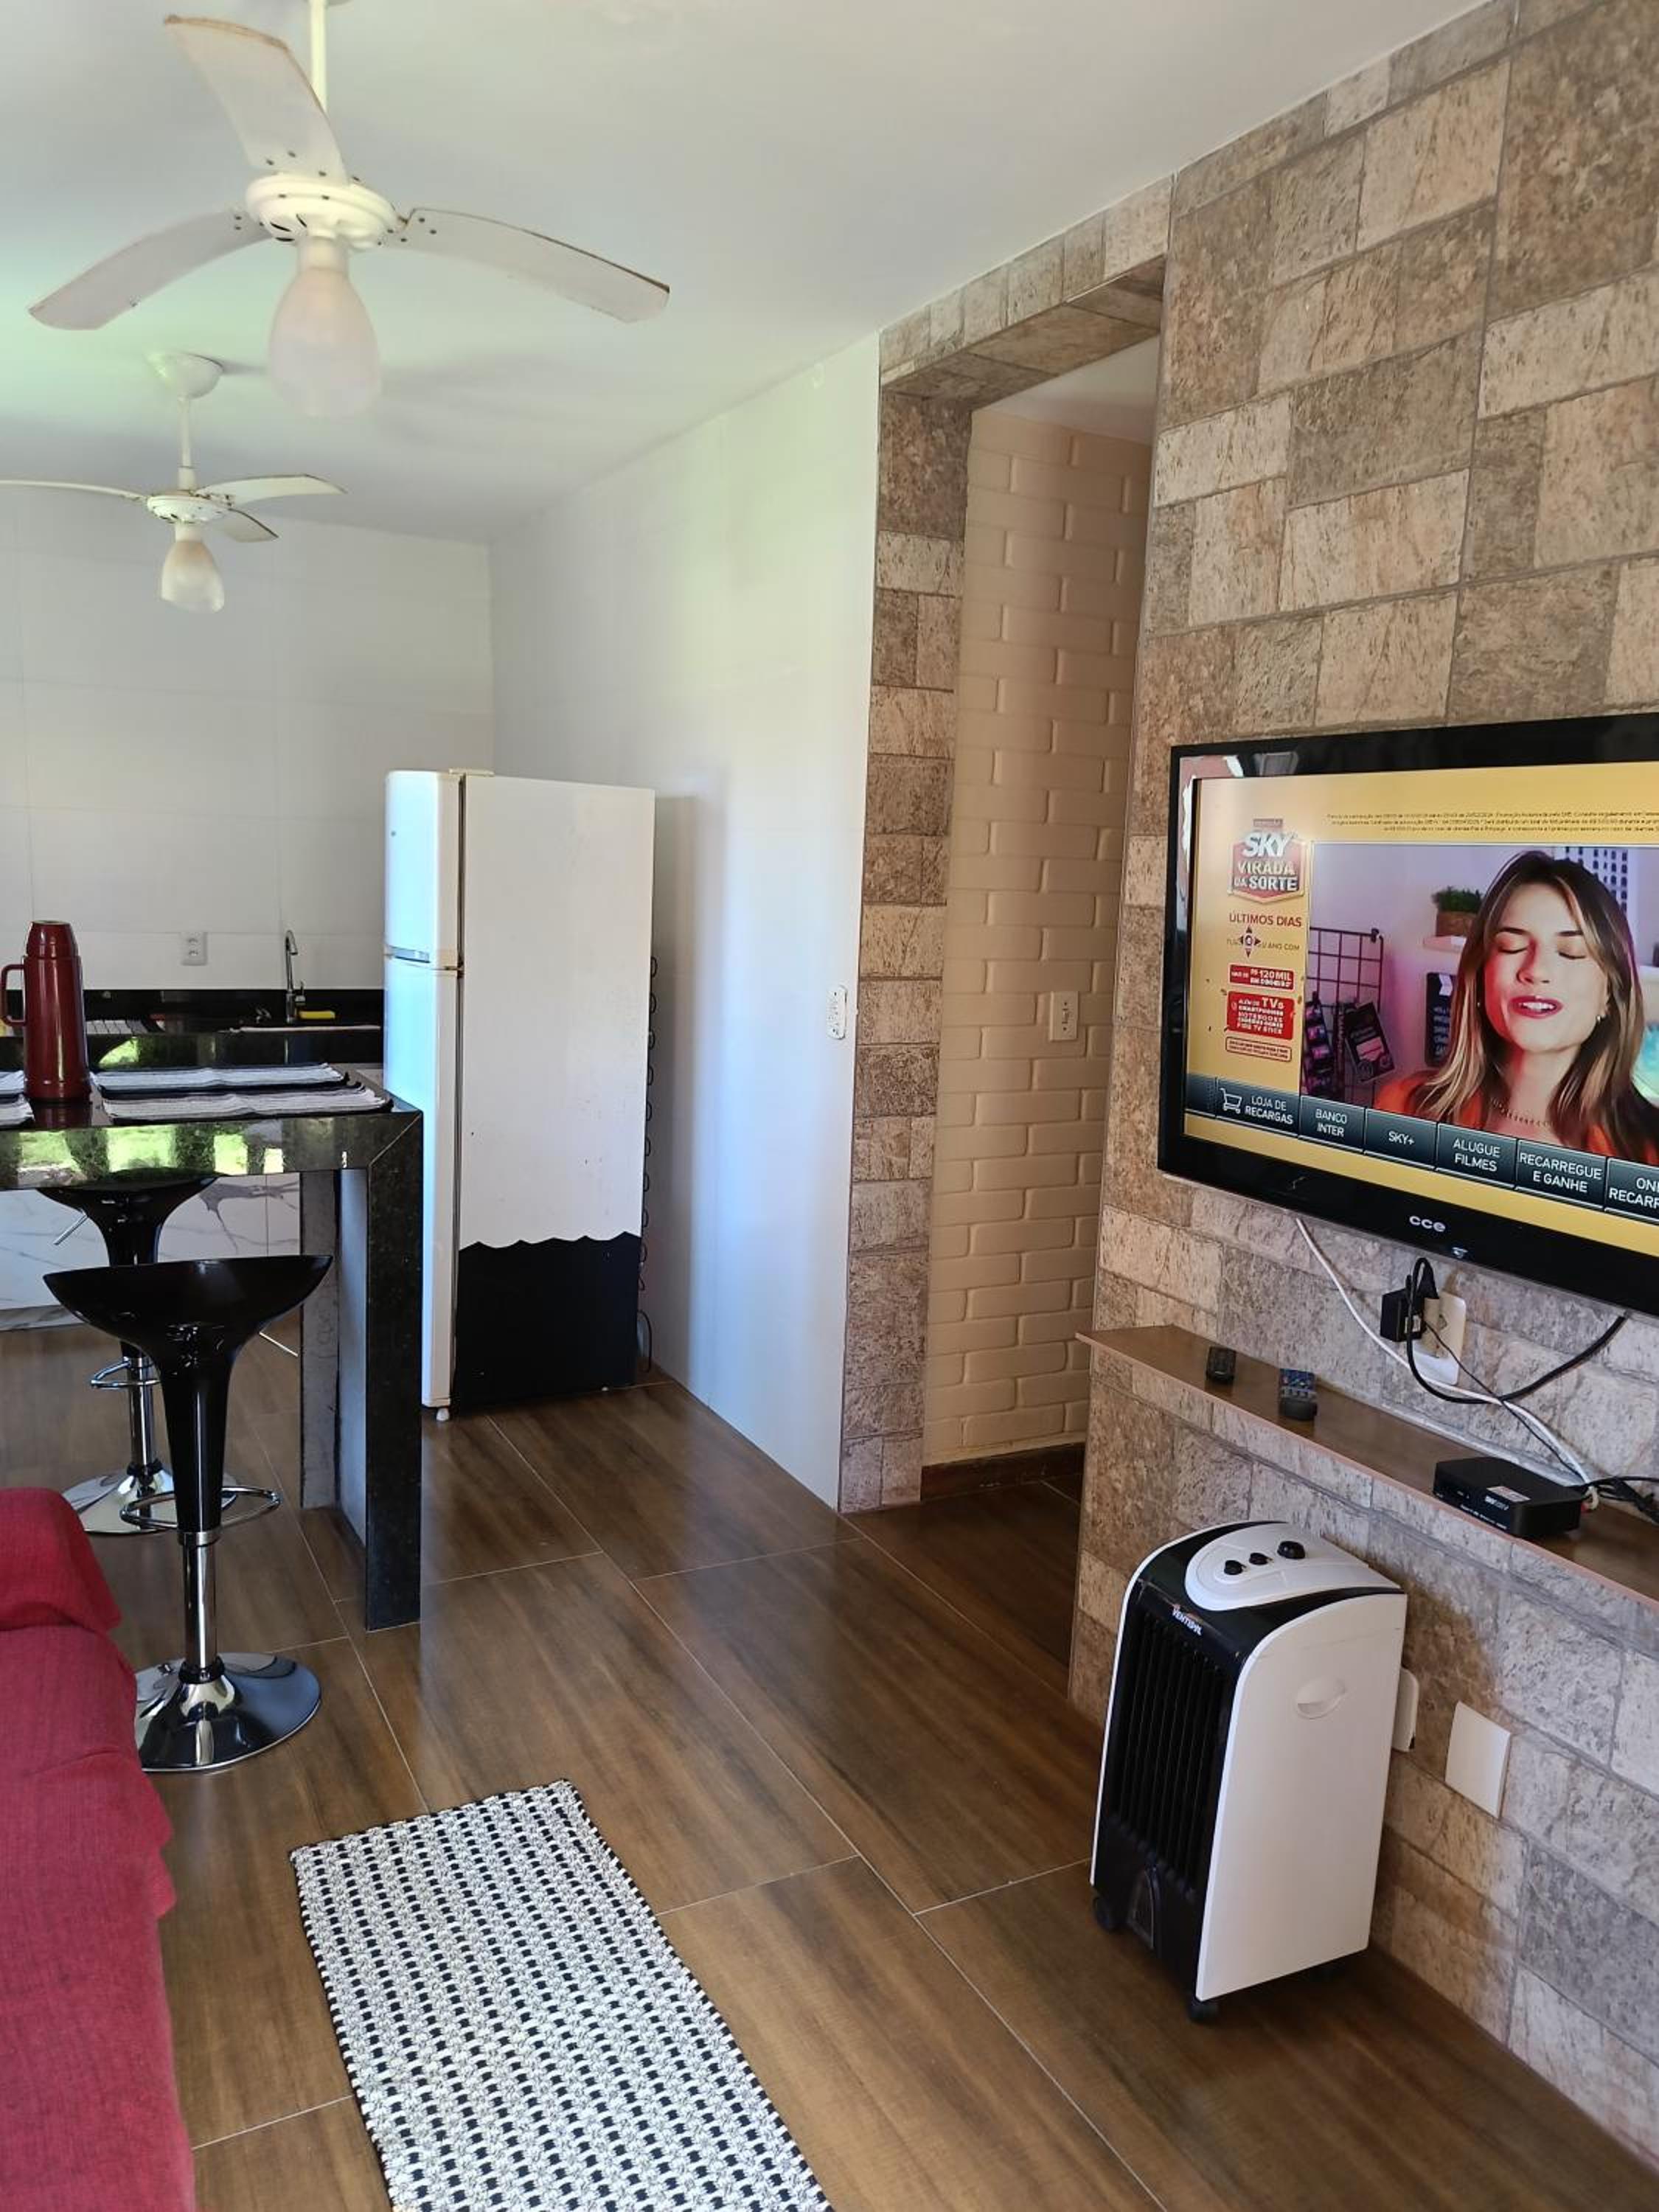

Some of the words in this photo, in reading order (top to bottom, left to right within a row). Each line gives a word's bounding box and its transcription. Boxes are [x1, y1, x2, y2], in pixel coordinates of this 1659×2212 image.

[1242, 831, 1290, 858] SKY
[1238, 860, 1295, 875] VIRADA
[1249, 875, 1298, 891] SORTE
[1229, 908, 1274, 925] ÚLTIMOS
[1276, 916, 1301, 928] DIAS
[1259, 970, 1275, 978] 120
[1276, 970, 1292, 981] MIL
[1251, 1095, 1273, 1108] LOJA
[1274, 1099, 1287, 1111] DE
[1245, 1105, 1293, 1125] RECARGAS
[1315, 1108, 1347, 1124] BANCO
[1317, 1123, 1344, 1137] INTER
[1388, 1130, 1415, 1145] SKY+
[1453, 1138, 1501, 1158] ALUGUE
[1455, 1152, 1498, 1172] FILMES
[1520, 1152, 1602, 1180] RECARREGUE
[1533, 1170, 1542, 1183] E
[1543, 1172, 1588, 1193] GANHE
